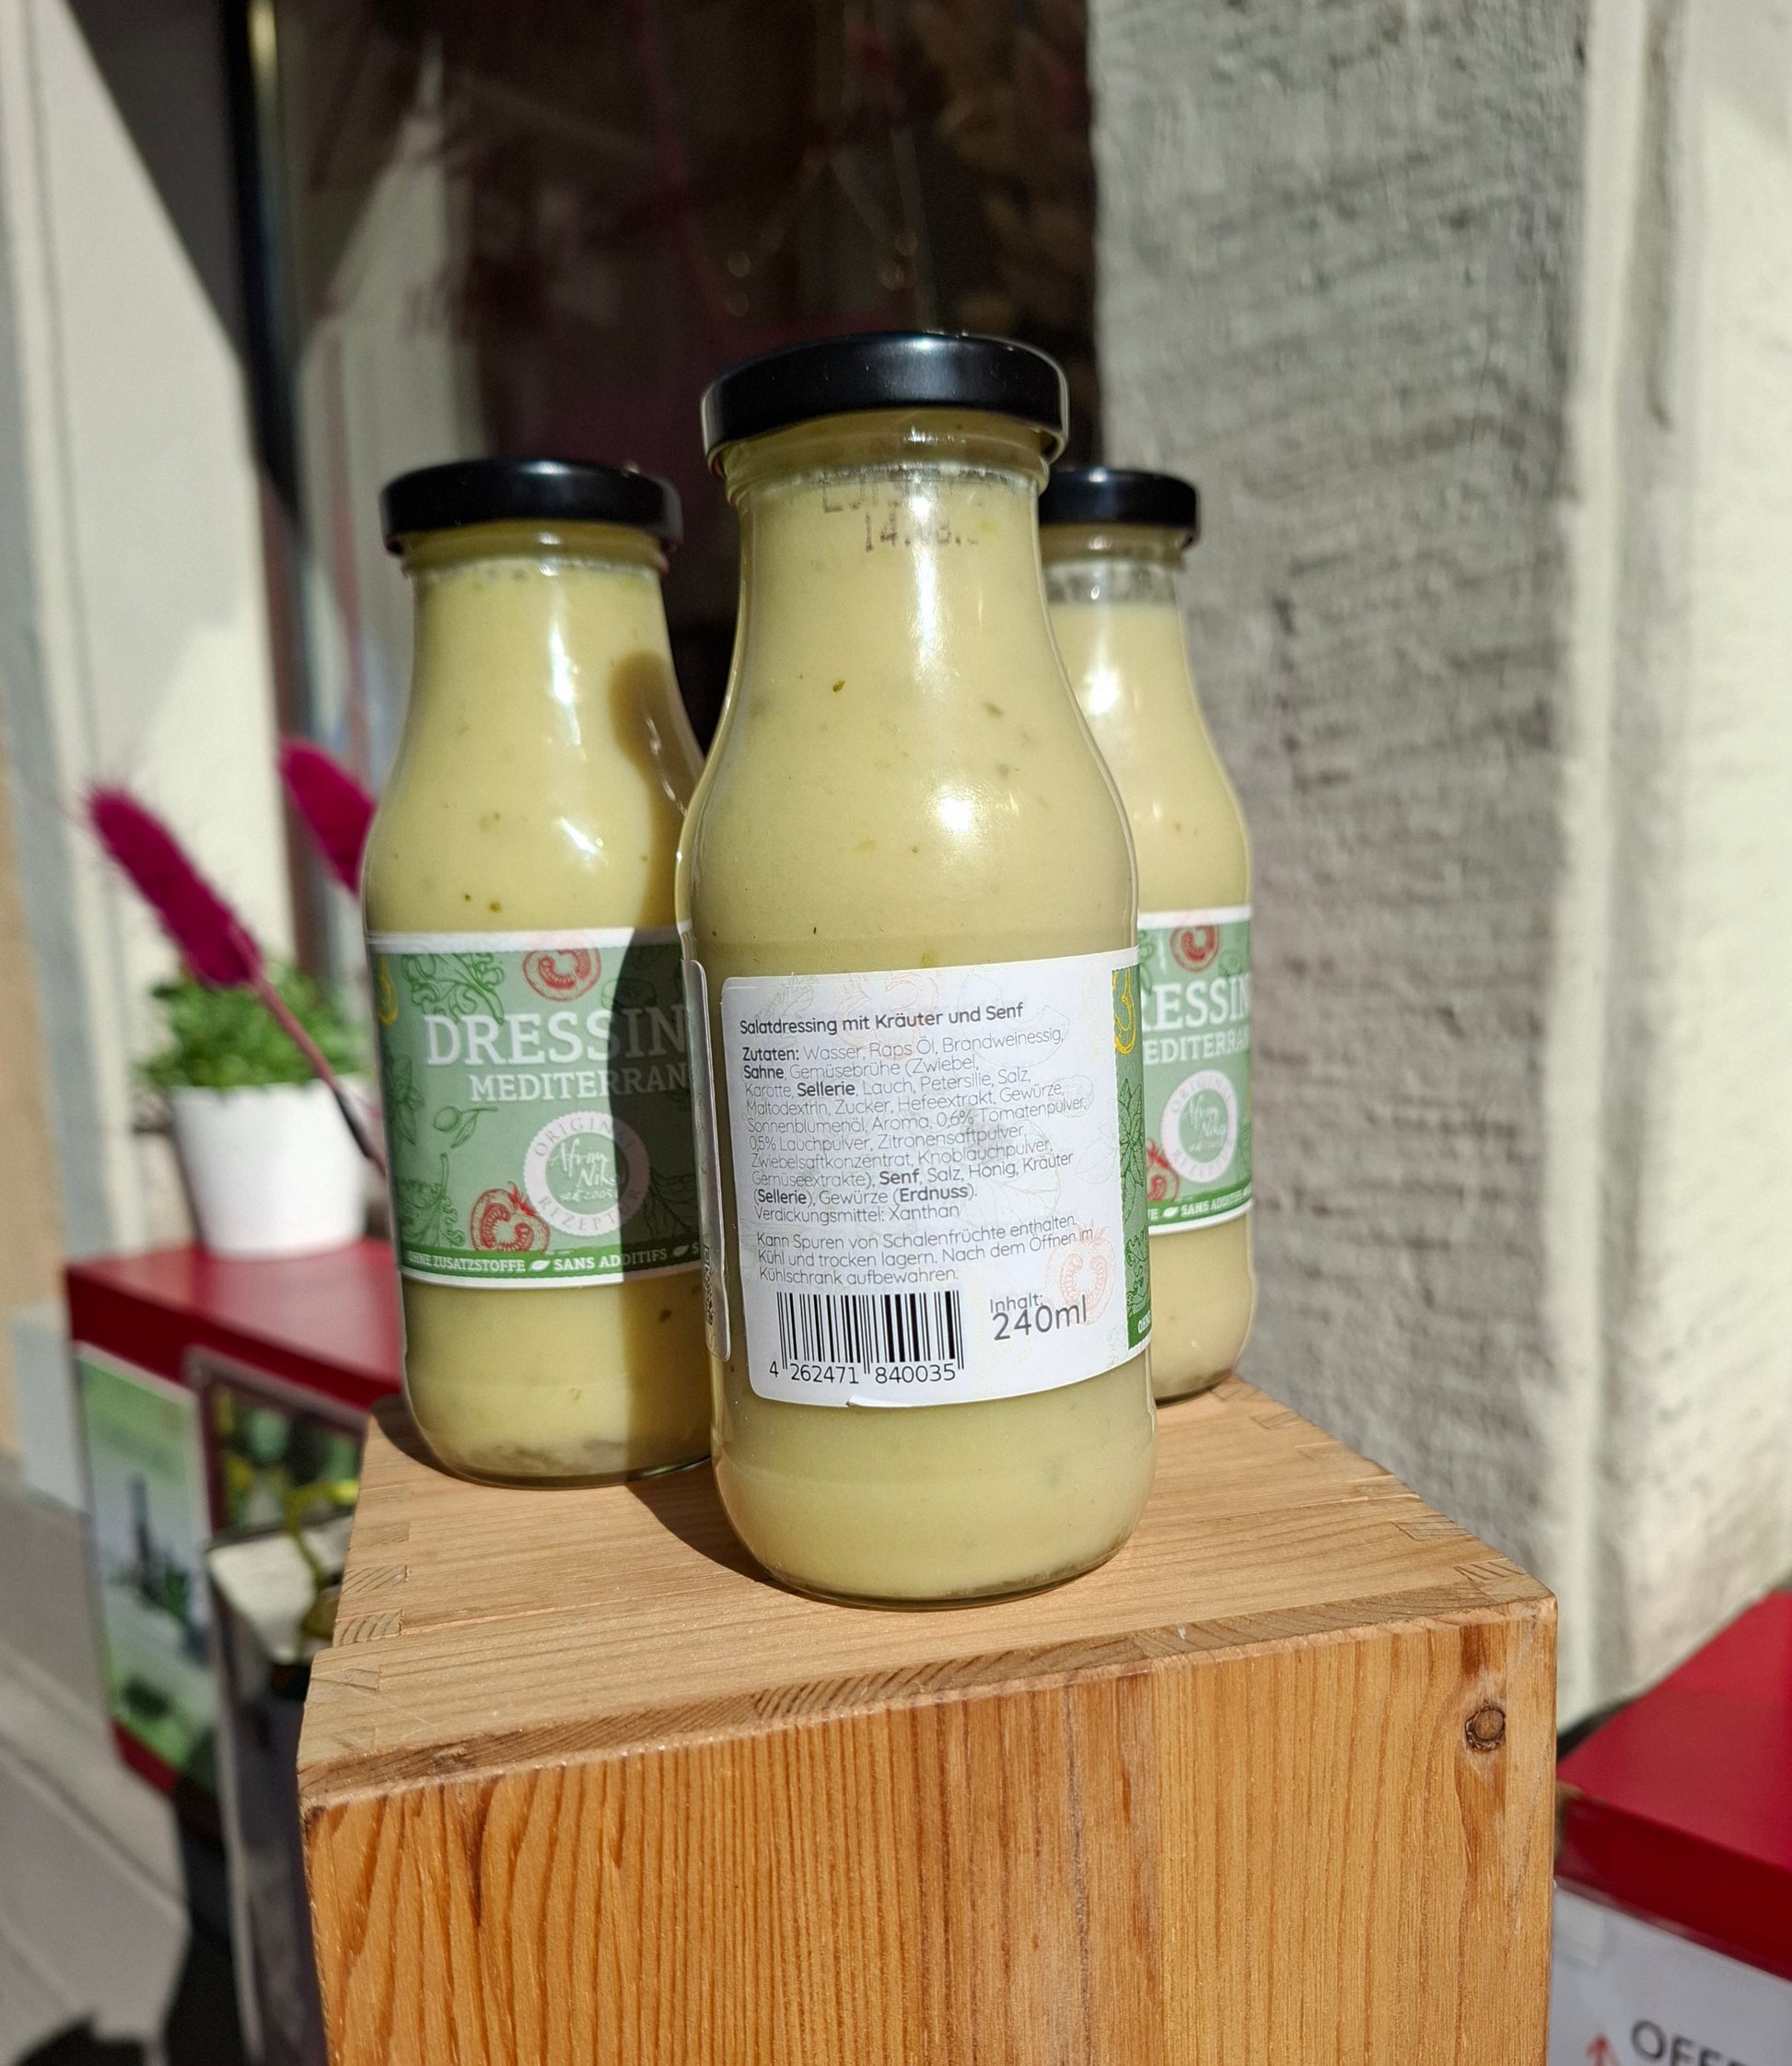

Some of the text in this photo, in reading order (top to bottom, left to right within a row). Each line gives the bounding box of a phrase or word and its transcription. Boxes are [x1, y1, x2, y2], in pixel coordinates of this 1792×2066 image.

[739, 1001, 1024, 1035] Salatdressing mit Kräuter und Senf
[741, 1046, 799, 1061] Zutaten:
[869, 1042, 913, 1059] Raps
[916, 1035, 938, 1055] Öl,
[942, 1027, 1064, 1054] Brandweinessig,
[743, 1054, 979, 1080] Sahne, Gemüsebrühe (Zwiebel,
[745, 1067, 1031, 1099] Karotte, Sellerie, Lauch, Petersilie, Salz,
[746, 1100, 831, 1116] Maltodextrin,
[834, 1098, 894, 1115] Zucker,
[999, 1082, 1065, 1103] Gewürze,
[747, 1116, 868, 1134] Sonnenblumenöl,
[872, 1115, 933, 1131] Aroma,
[936, 1109, 973, 1128] 0,6%
[749, 1135, 776, 1151] 0,5%
[779, 1135, 874, 1153] Lauchpulver,
[751, 1152, 913, 1170] Zwiebelsaftkonzentrat,
[751, 1151, 1074, 1189] Gemüseextrakte), Senf, Salz, Honig, Kräuter
[753, 1183, 978, 1208] (Sellerie), Gewürze (Erdnuss).
[754, 1205, 960, 1226] Verdickungsmittel: Xanthan
[757, 1215, 1076, 1253] Kann Spuren von Schalenfrüchte enthalten.
[433, 1255, 526, 1272] ZUSATZSTOFFE
[553, 1256, 595, 1271] SANS
[599, 1248, 668, 1268] ADDITIFS
[758, 1227, 1094, 1268] Kühl und trocken lagern. Nach dem Öffnen im
[759, 1266, 960, 1285] Kühlschrank aufbewahren.
[990, 1292, 1043, 1313] Inhalt:
[992, 1293, 1088, 1341] 240ml
[769, 1360, 957, 1384] 4 262471 840035
